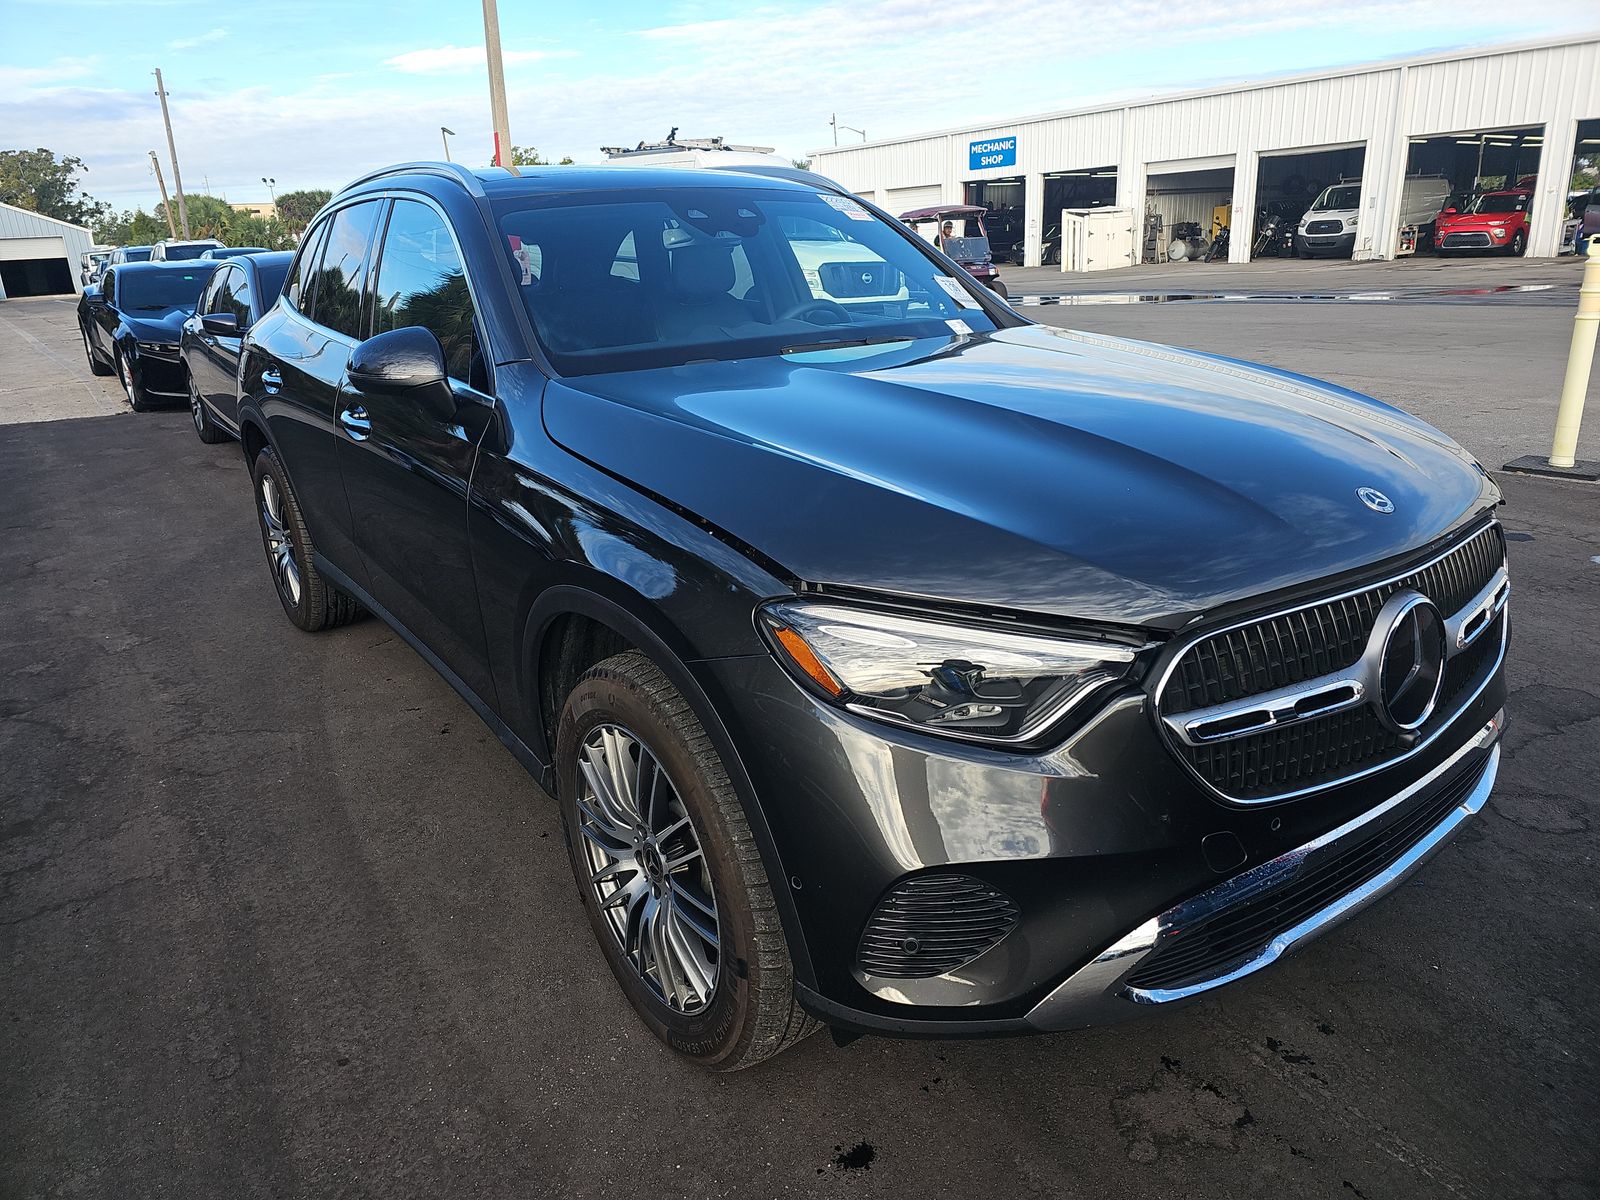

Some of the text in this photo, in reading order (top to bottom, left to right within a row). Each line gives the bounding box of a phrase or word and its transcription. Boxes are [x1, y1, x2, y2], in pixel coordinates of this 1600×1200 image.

[971, 140, 1015, 154] MECHANIC
[981, 154, 1004, 166] SHOP
[671, 1007, 733, 1054] PRIMACY ALL SEASON
